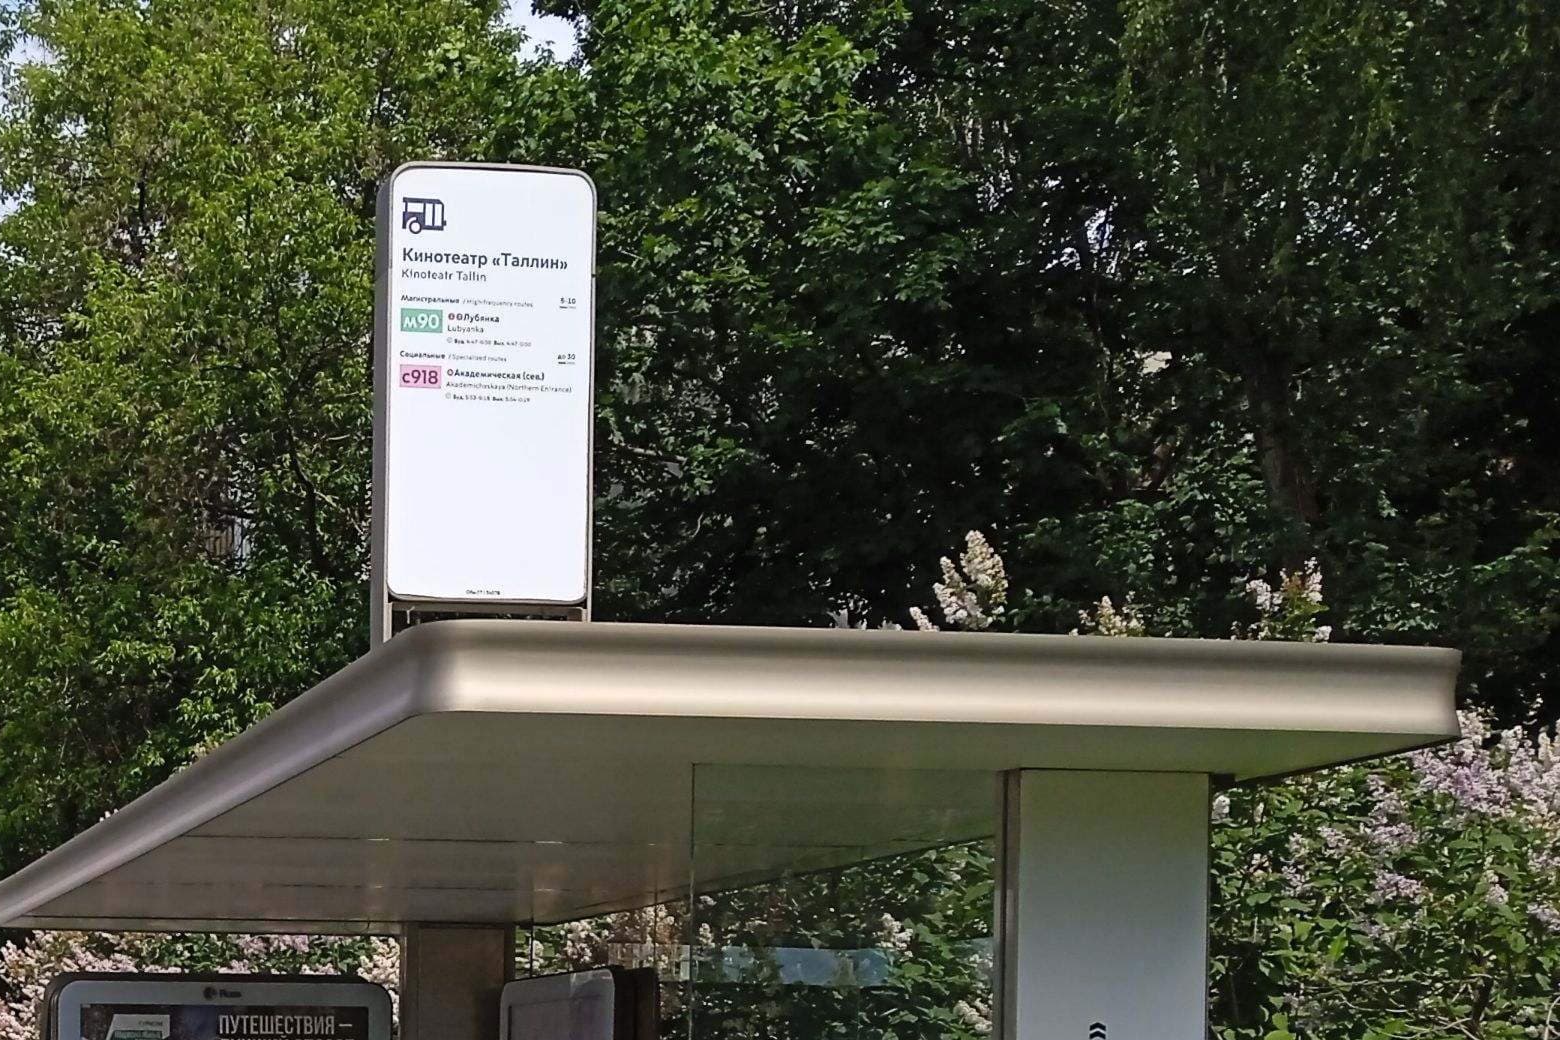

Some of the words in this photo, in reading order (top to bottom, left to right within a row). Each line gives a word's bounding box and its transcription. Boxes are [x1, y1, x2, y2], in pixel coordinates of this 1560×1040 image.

[402, 247, 488, 268] Кинотеатр
[492, 252, 568, 270] «Таллин»
[401, 269, 453, 280] Kinoteatr
[456, 271, 487, 282] Tallin
[463, 314, 500, 324] Лубянка
[402, 369, 439, 385] с918
[218, 1015, 335, 1035] ПУТЕШЕСТВИЯ
